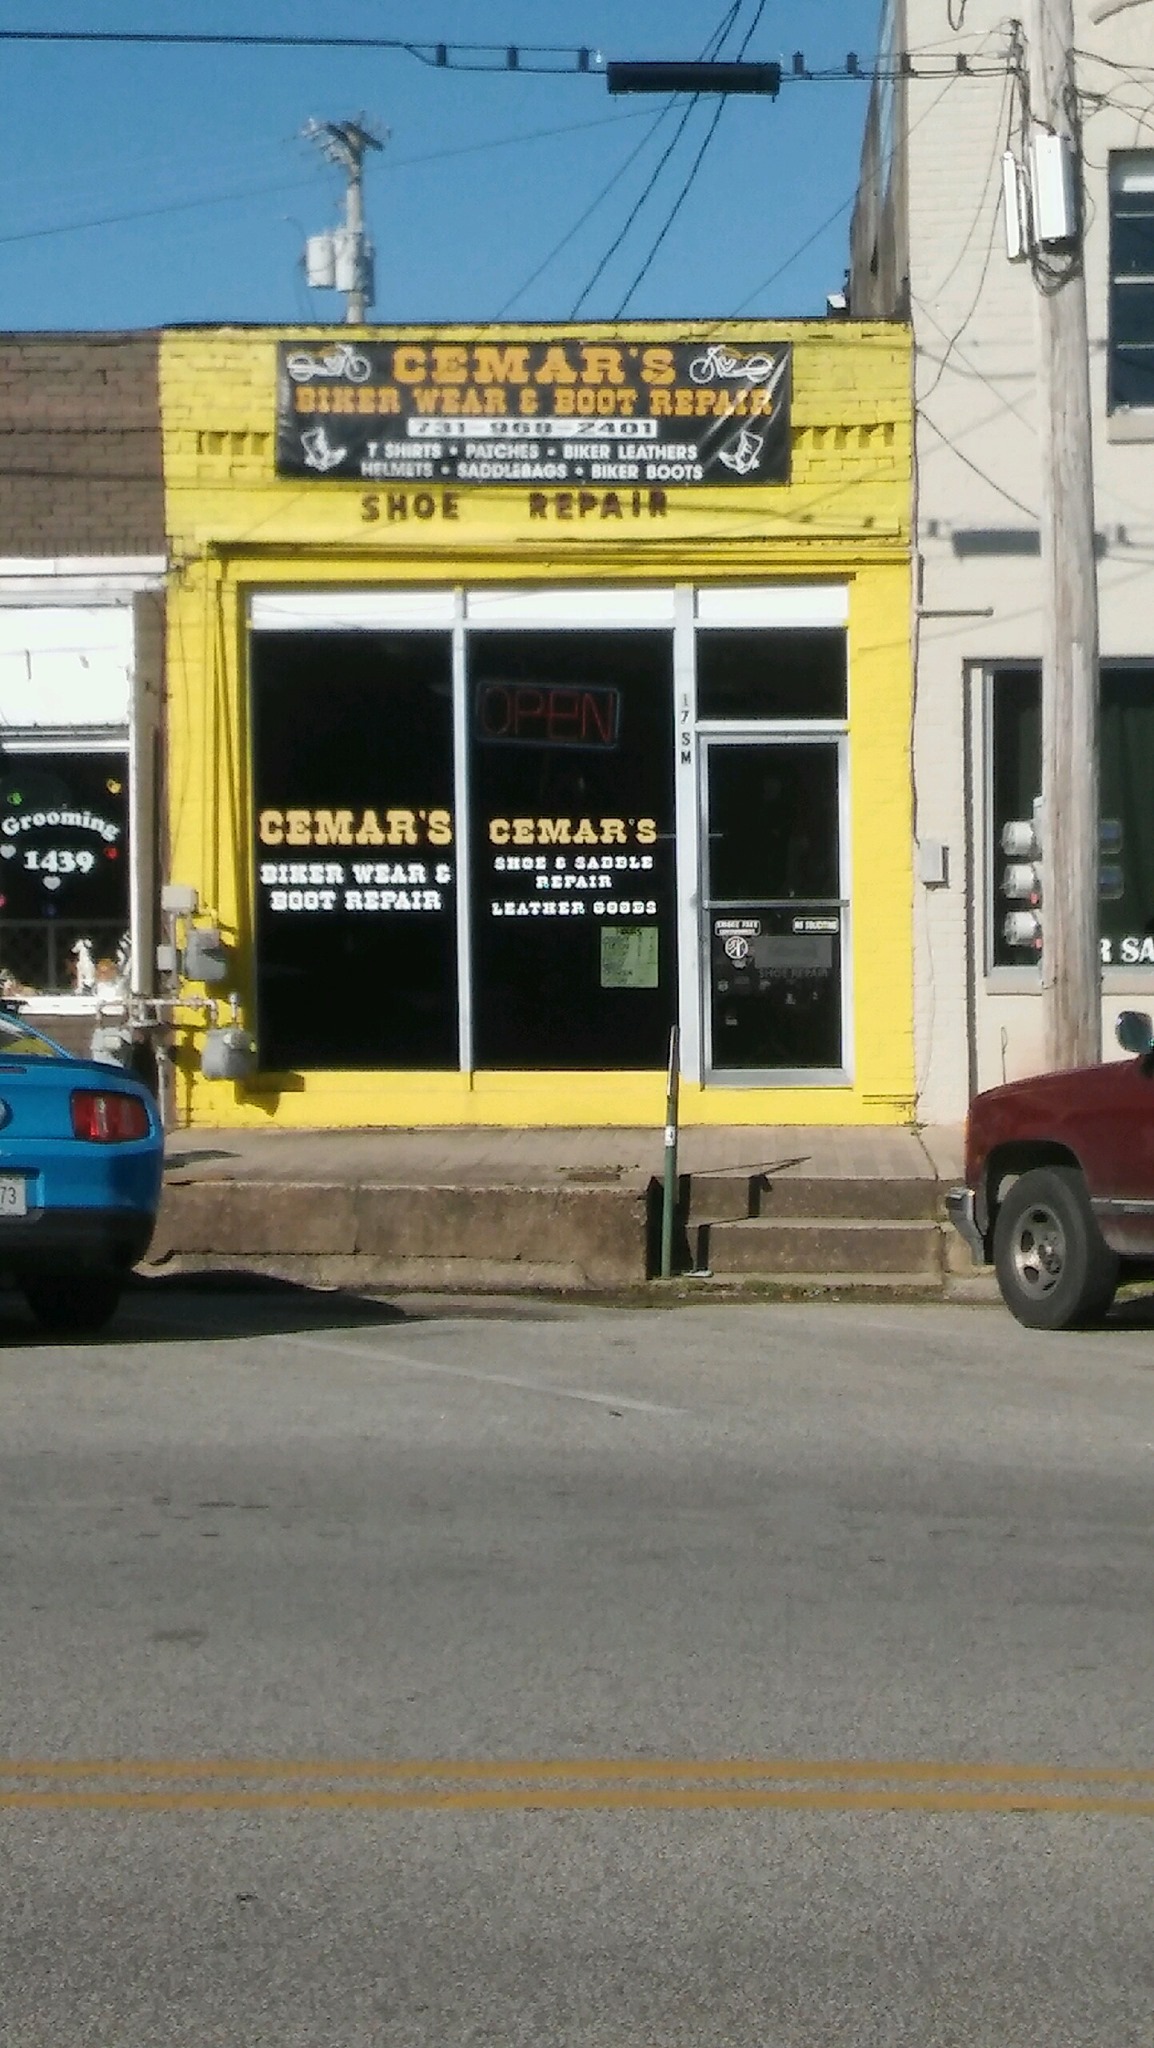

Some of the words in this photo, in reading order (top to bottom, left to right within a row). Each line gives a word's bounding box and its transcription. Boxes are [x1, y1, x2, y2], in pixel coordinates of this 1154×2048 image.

[392, 345, 676, 385] CEMAR'S
[295, 386, 400, 413] BIKER
[412, 386, 507, 414] WEAR
[519, 386, 538, 414] &
[554, 387, 637, 416] BOOT
[650, 388, 772, 416] REPAIR
[384, 442, 441, 459] SHIRTS
[465, 443, 540, 460] PATCHES
[563, 444, 611, 460] BIKER
[617, 444, 698, 461] LEATHERS
[361, 462, 433, 478] HELMETS
[457, 462, 568, 479] SADDLEBAGS
[591, 464, 639, 480] BIKER
[646, 464, 703, 481] BOOTS
[361, 493, 460, 521] SHOE
[528, 490, 669, 520] REPAIR
[479, 687, 616, 743] OPEN
[1, 811, 121, 842] Grooming
[259, 810, 452, 845] CEMAR'S
[488, 818, 657, 845] CEMAR'S
[23, 850, 96, 874] 1439
[260, 863, 345, 885] BIKER
[352, 863, 426, 884] WEAR
[435, 863, 451, 884] &
[494, 856, 547, 871] SHOE
[555, 856, 566, 870] &
[574, 856, 653, 871] SADDLE
[535, 875, 612, 889] REPAIR
[270, 889, 336, 911] BOOT
[344, 890, 442, 911] REPAIR
[492, 902, 585, 915] LEATHER
[593, 901, 657, 915] GOODS
